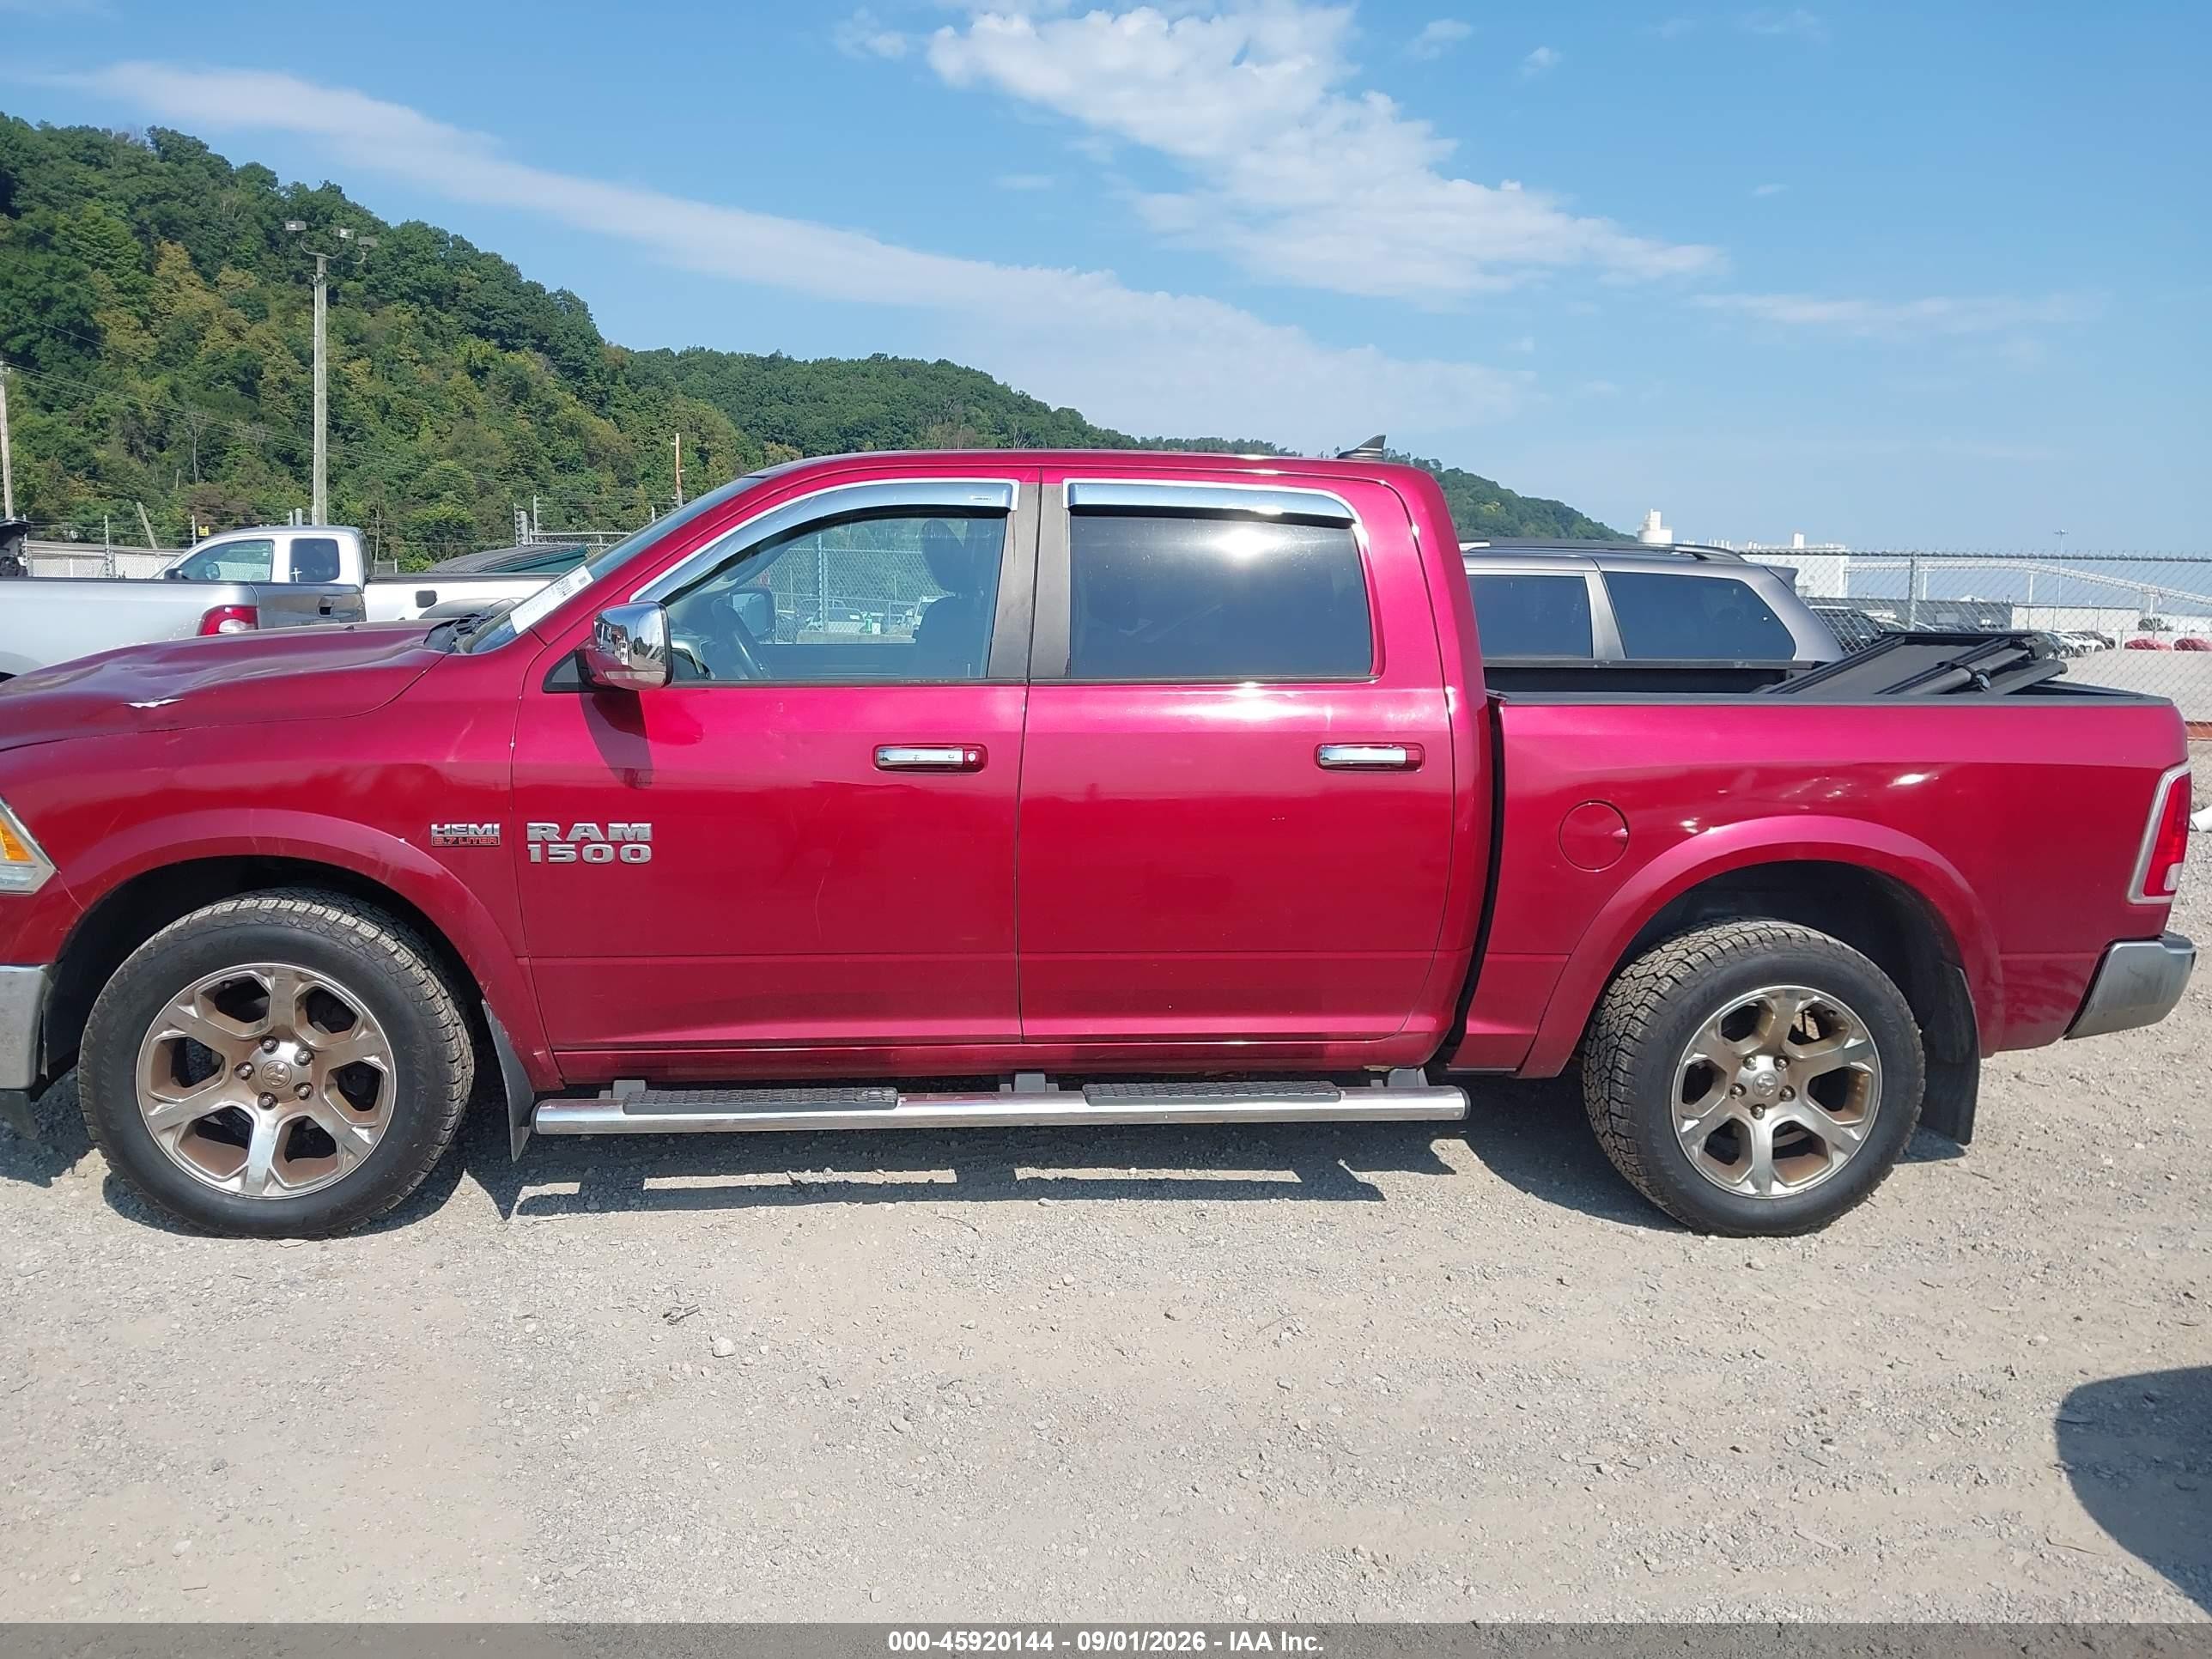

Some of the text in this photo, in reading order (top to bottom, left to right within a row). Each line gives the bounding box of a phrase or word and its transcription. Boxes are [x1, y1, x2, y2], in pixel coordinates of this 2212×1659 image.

[431, 823, 501, 836] HEMI
[527, 822, 653, 842] RAM
[434, 836, 499, 845] 5.7 LITER
[527, 844, 652, 863] 1500
